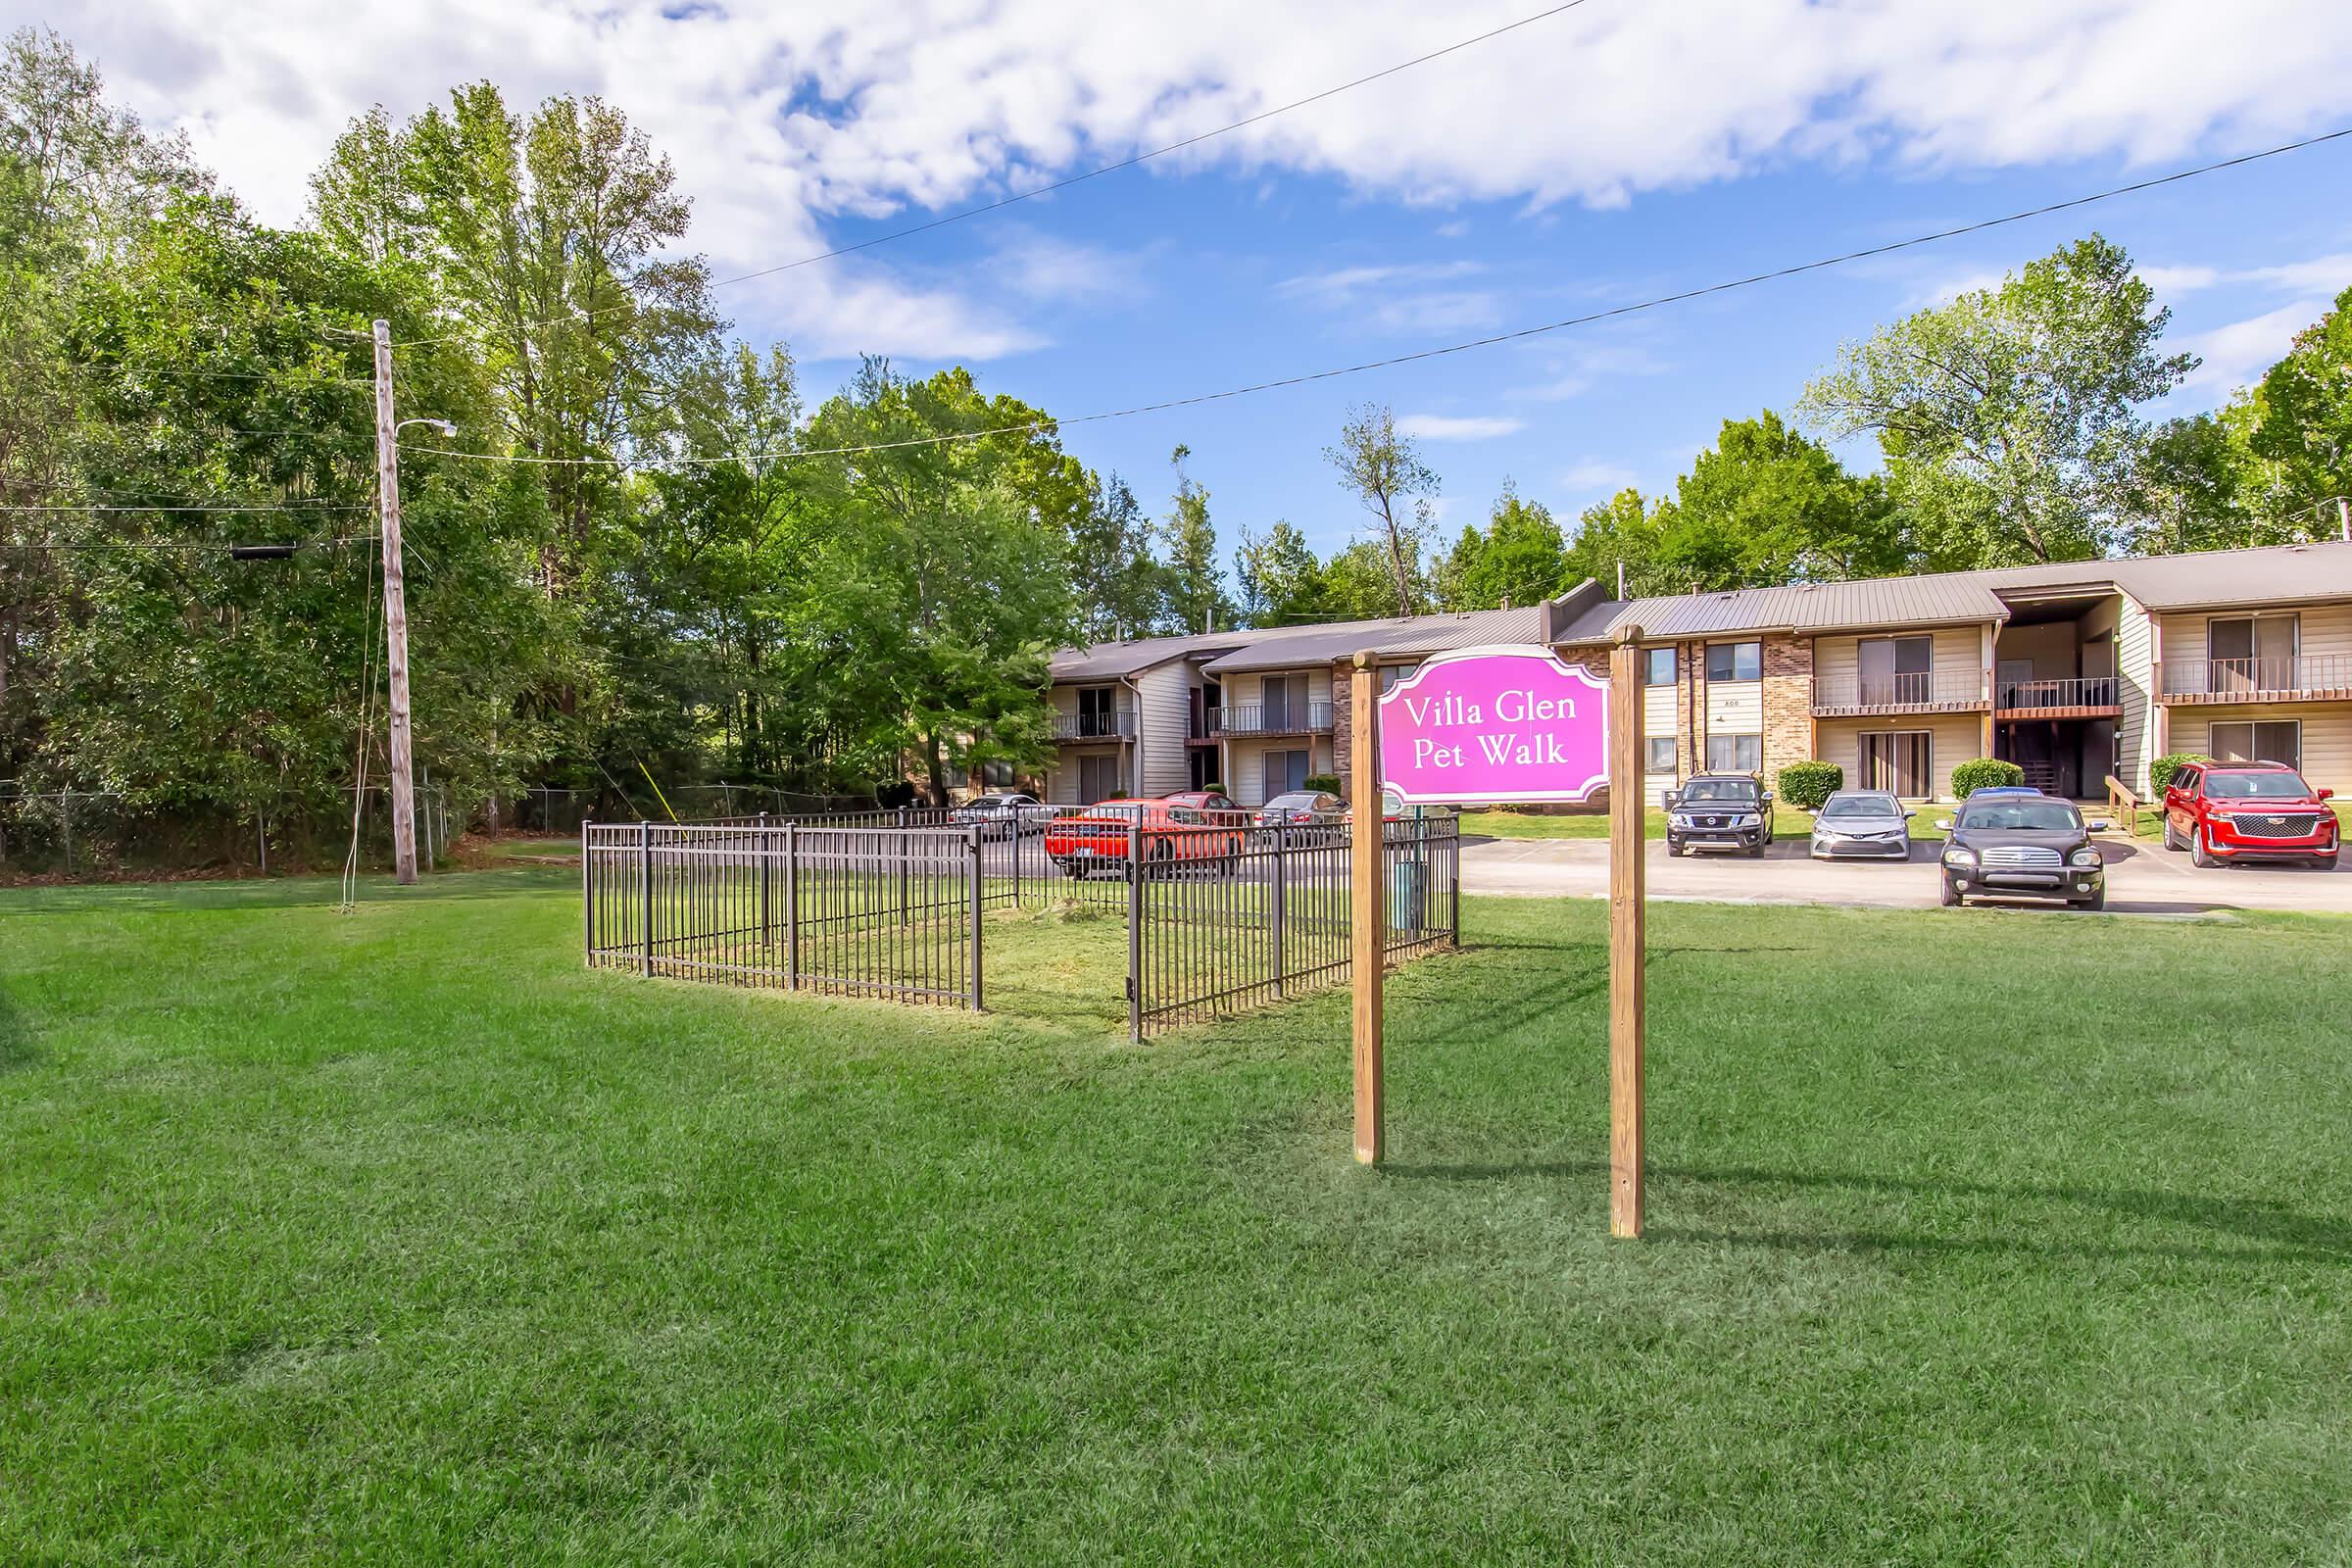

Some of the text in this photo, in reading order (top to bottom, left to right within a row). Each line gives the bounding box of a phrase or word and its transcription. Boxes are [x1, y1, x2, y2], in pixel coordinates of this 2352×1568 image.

[1404, 690, 1577, 728] Villa Glen
[1413, 733, 1569, 769] Pet Walk
